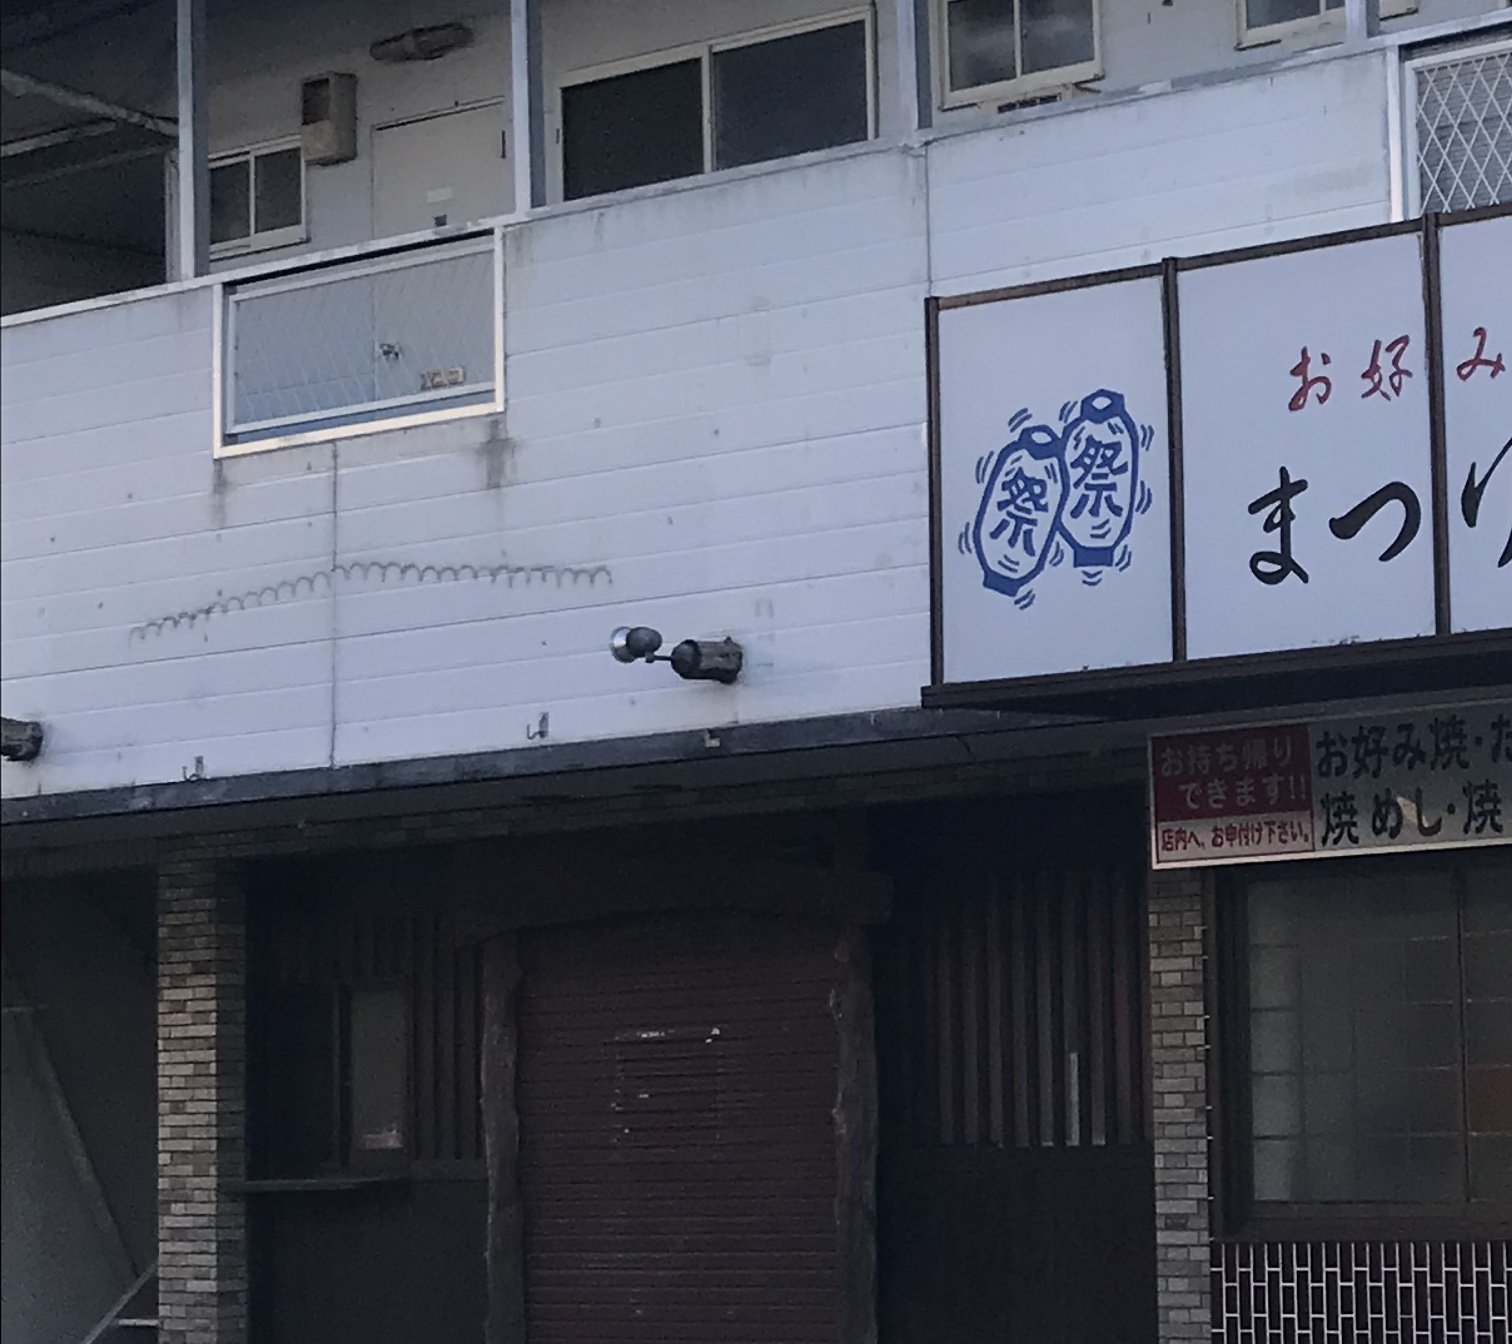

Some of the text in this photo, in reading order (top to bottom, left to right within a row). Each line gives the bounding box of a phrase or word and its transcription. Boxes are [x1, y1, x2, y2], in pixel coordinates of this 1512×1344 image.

[986, 466, 1053, 561] 祭
[1066, 436, 1134, 523] 祭
[1160, 735, 1293, 777] お持ち帰り
